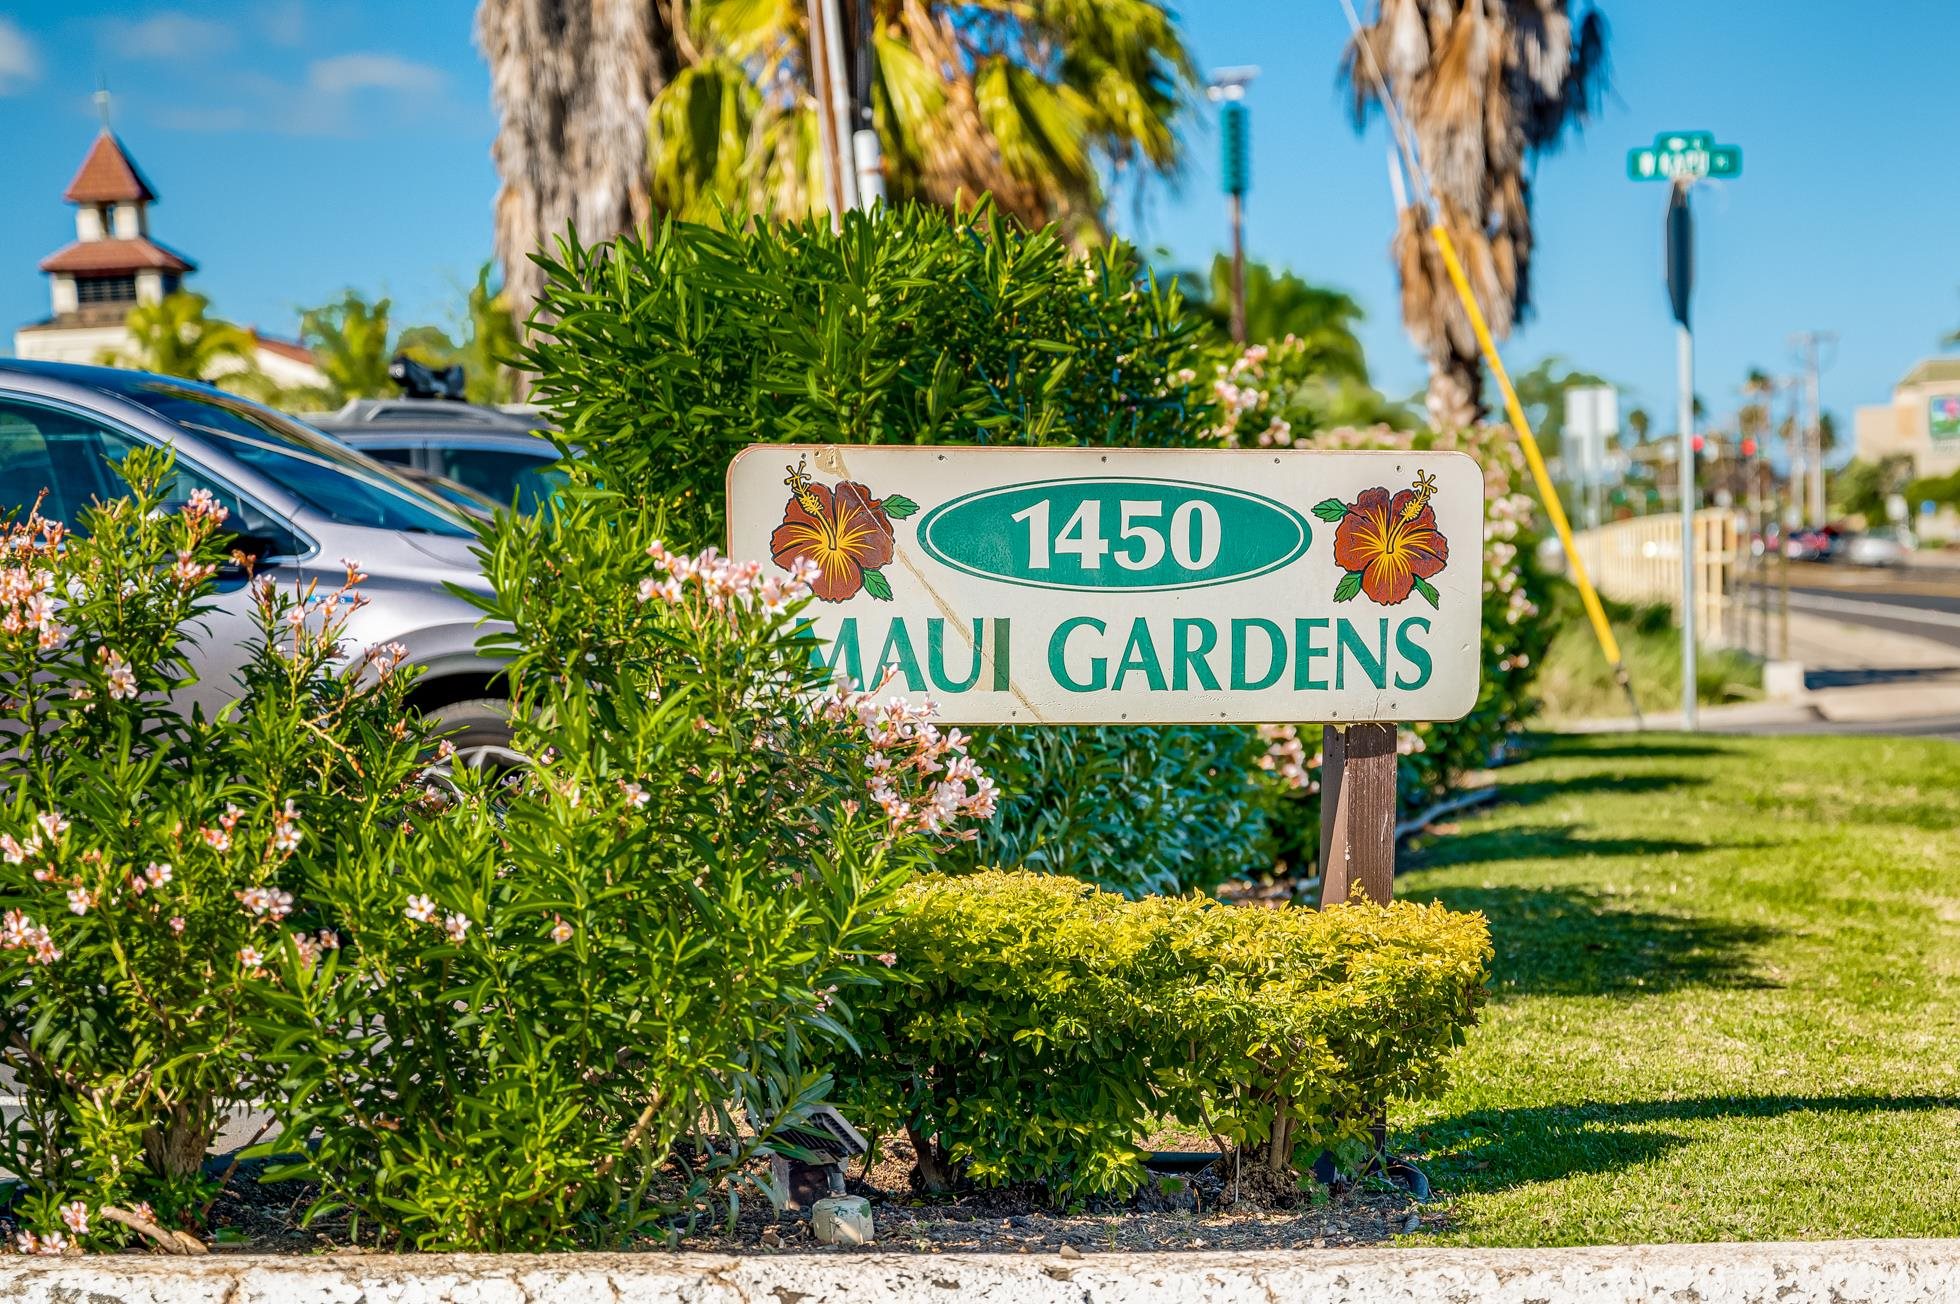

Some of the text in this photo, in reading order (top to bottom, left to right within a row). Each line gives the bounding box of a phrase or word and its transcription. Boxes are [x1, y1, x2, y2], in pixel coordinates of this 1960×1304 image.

[1011, 499, 1222, 570] 1450
[795, 616, 1433, 692] MAUI GARDENS
